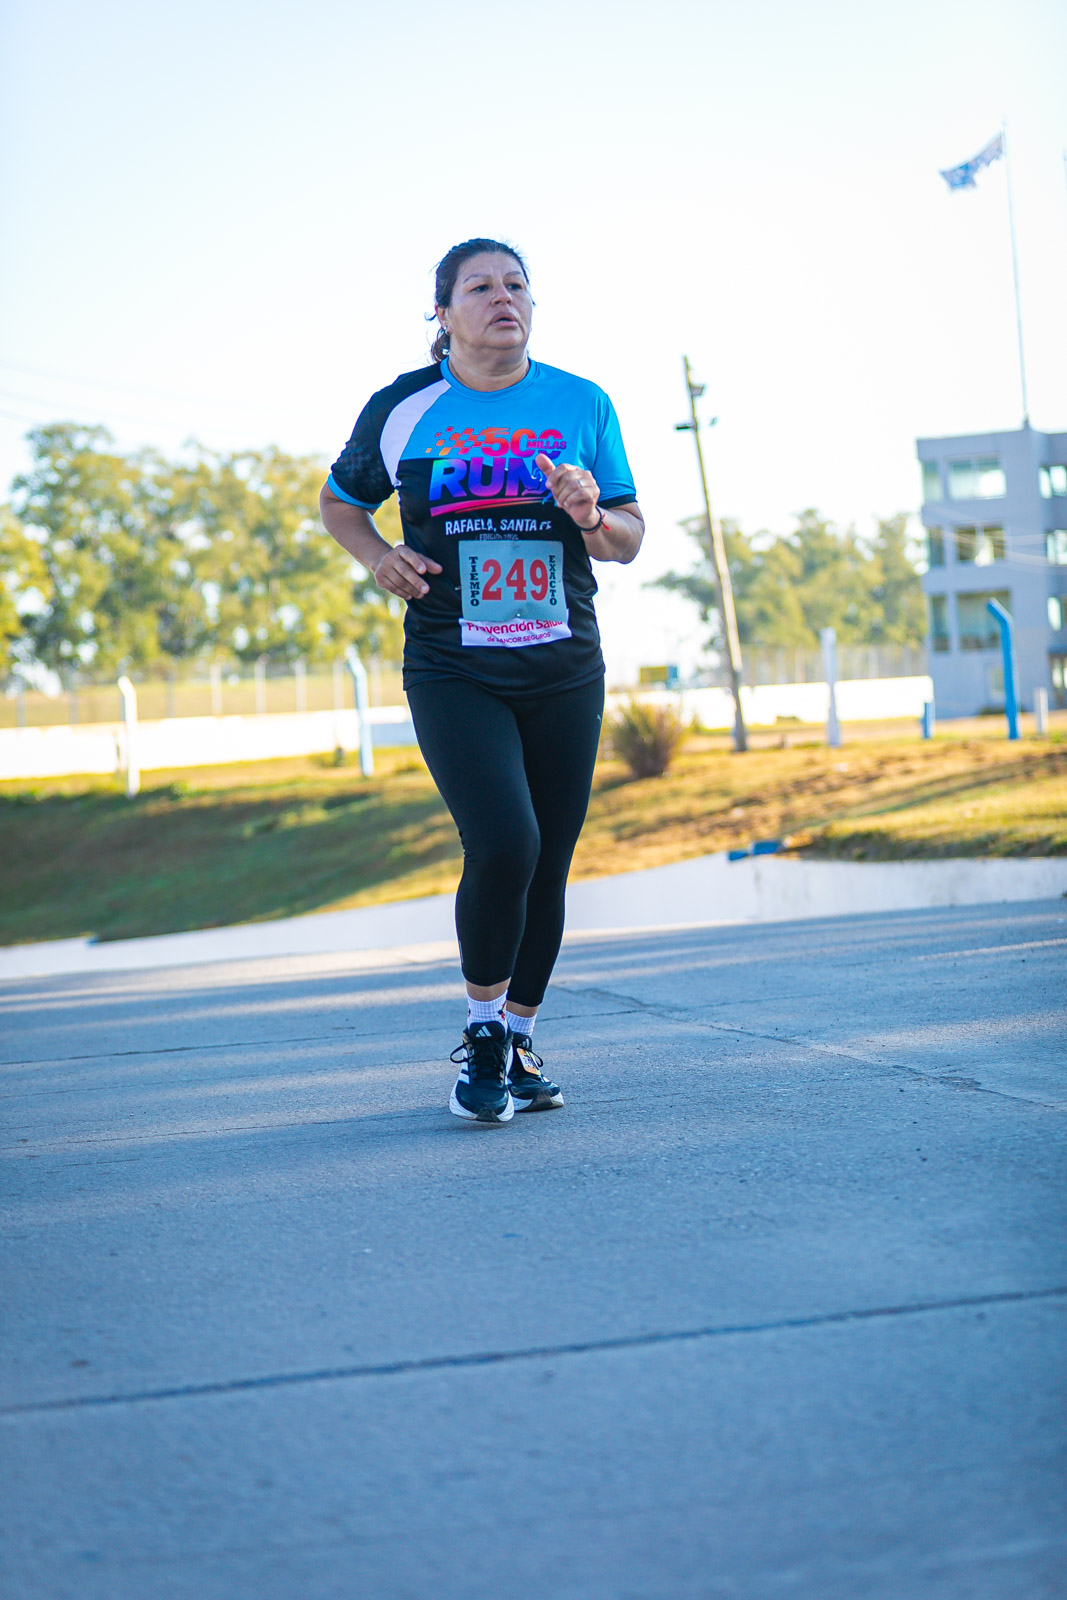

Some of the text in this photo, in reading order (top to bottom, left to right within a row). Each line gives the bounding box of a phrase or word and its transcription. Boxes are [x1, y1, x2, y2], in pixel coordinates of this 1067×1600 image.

[526, 440, 567, 450] MILLAS
[429, 457, 551, 501] RUN
[445, 518, 497, 536] RAFAELA,
[500, 518, 538, 532] SANTA
[468, 556, 480, 607] TIEMPO
[481, 558, 549, 602] 249
[548, 554, 558, 606] EXACTO
[522, 631, 551, 642] SEGUROS
